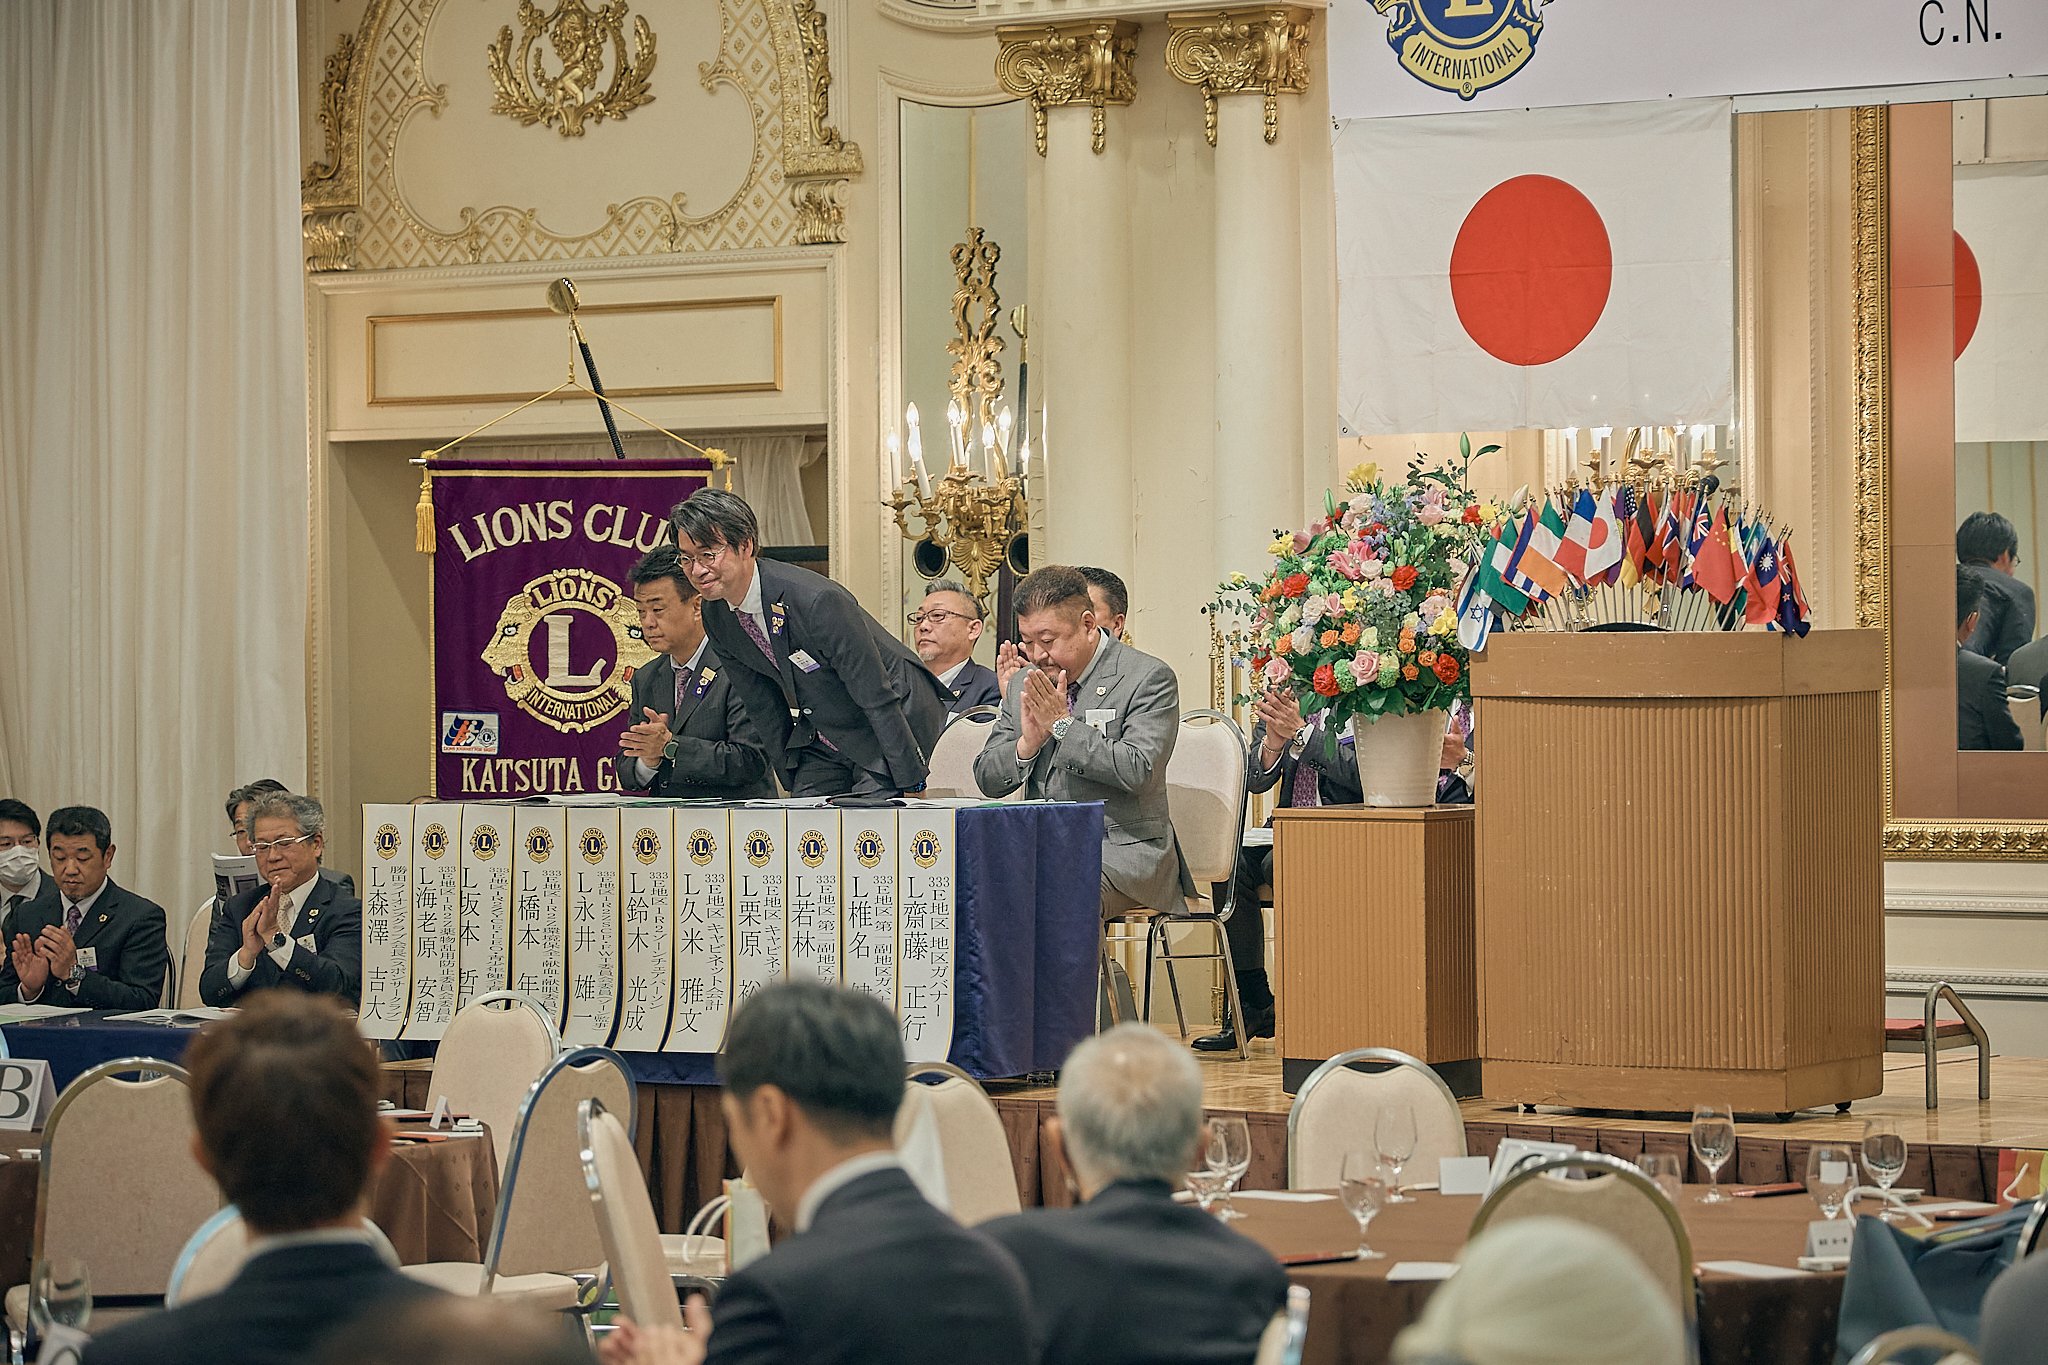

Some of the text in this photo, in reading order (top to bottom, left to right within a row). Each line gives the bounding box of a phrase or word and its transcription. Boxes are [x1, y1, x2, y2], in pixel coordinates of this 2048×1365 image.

[1920, 0, 2002, 46] C.N.
[1410, 37, 1523, 80] INTERNATIONAL
[447, 499, 672, 563] LIONS CLU
[532, 577, 614, 609] LIONS
[543, 614, 607, 687] L
[526, 689, 619, 720] INTERNATIONAL
[461, 756, 623, 793] KATSUTA G
[380, 825, 396, 833] LIONS
[384, 834, 392, 848] L
[427, 825, 443, 833] LIONS
[432, 834, 440, 848] L
[477, 826, 495, 834] LIONS
[481, 835, 490, 849] L
[531, 828, 548, 836] LIONS
[536, 837, 544, 851] L
[584, 829, 602, 837] LIONS
[590, 839, 598, 853] L
[638, 829, 656, 837] LIONS
[643, 839, 651, 853] L
[693, 830, 711, 839] LIONS
[698, 840, 707, 854] L
[750, 831, 767, 840] LIONS
[804, 831, 822, 840] LIONS
[860, 831, 878, 840] LIONS
[917, 831, 935, 840] LIONS
[755, 841, 764, 855] L
[809, 841, 818, 855] L
[865, 841, 874, 855] L
[921, 841, 930, 855] L
[367, 867, 389, 945] L森澤
[415, 867, 437, 958] L海老原
[517, 870, 540, 950] L橋本
[574, 872, 596, 952] L永井
[626, 872, 649, 953] L鈴木
[680, 873, 704, 955] L久米
[762, 874, 782, 920] 333E地区
[816, 875, 836, 916] 333E地区
[873, 875, 893, 917] 333E地区
[738, 875, 762, 957] L栗原
[791, 875, 816, 958] L若林
[848, 876, 873, 959] L椎名
[704, 873, 726, 1011] 333E地区 キャビネット会計
[928, 876, 950, 1017] 333E地区 地区ガバナー
[363, 966, 388, 1020] 吉大
[414, 976, 437, 1023] 安智
[517, 972, 540, 1003] 年
[573, 974, 596, 1018] 雄一
[622, 975, 648, 1032] 光成
[676, 977, 704, 1033] 雅文
[902, 984, 928, 1042] 正行
[0, 1064, 34, 1119] B
